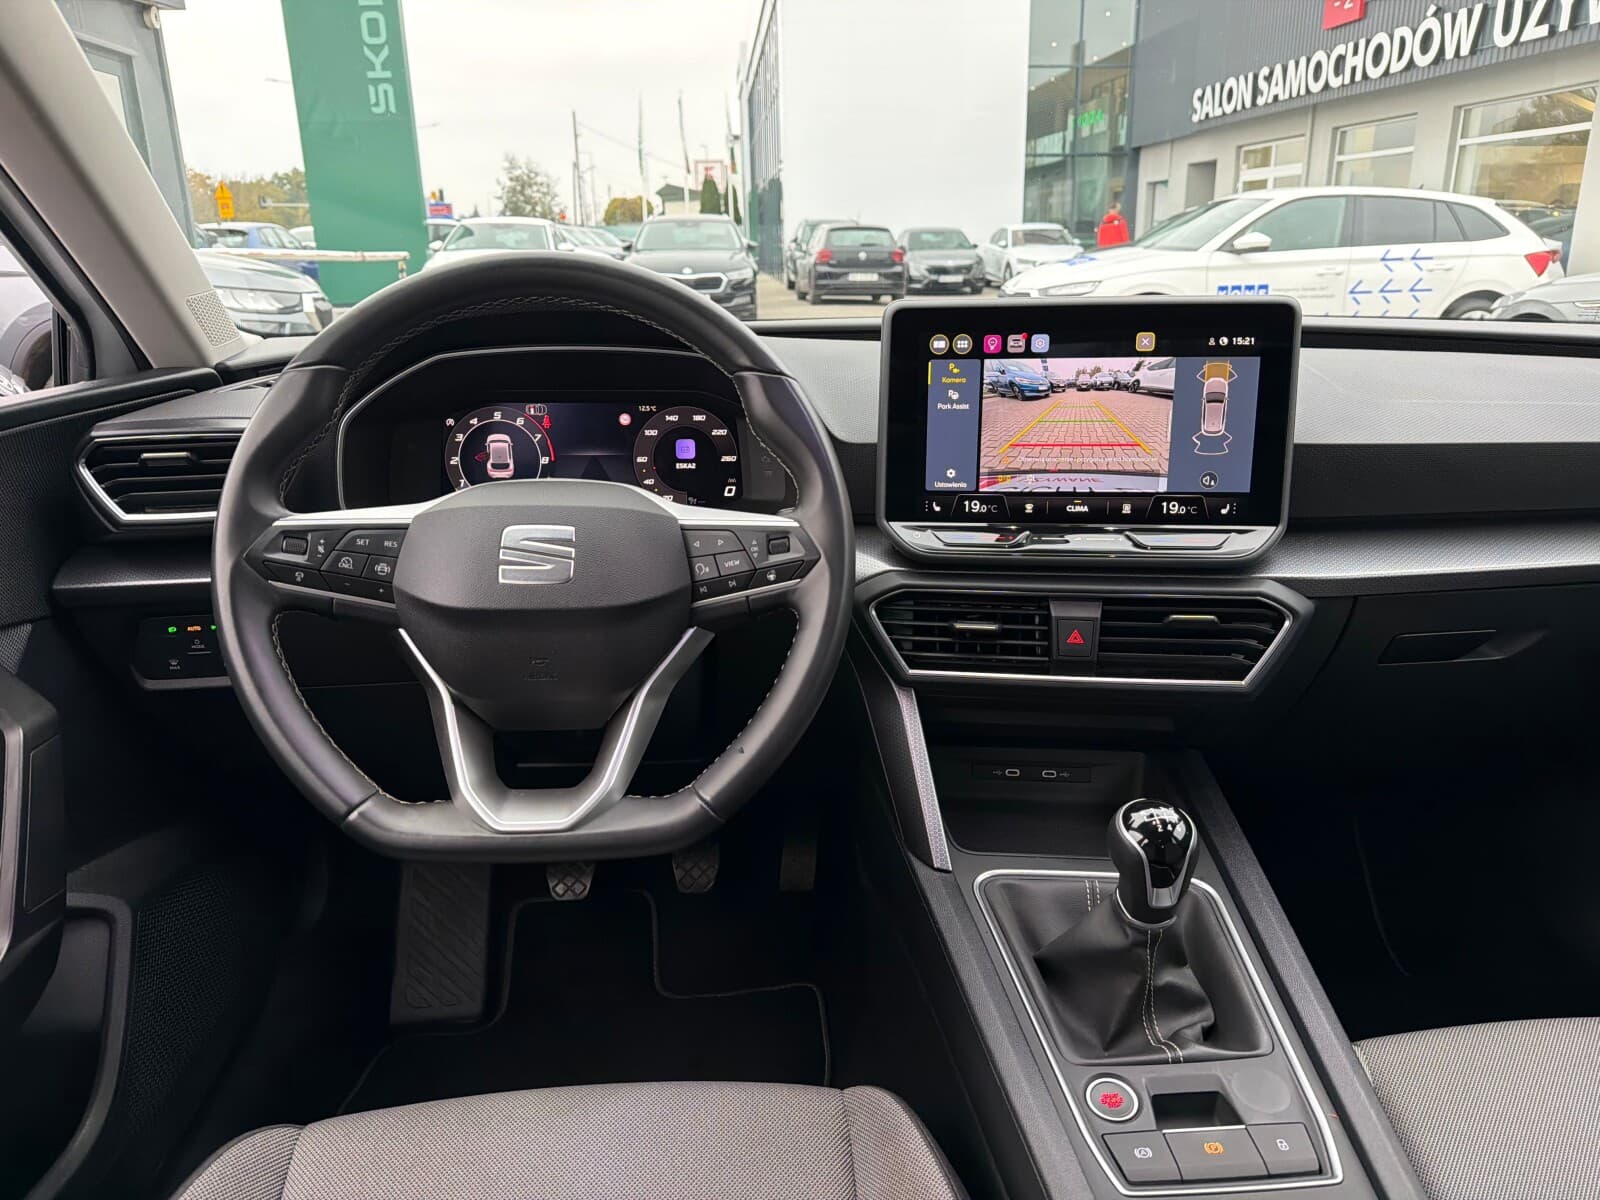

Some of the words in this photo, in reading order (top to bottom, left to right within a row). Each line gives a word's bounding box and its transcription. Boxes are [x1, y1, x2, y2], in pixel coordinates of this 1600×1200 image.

[1191, 72, 1254, 123] SALON
[1256, 3, 1483, 106] SAMOCHODÓW
[1232, 336, 1255, 346] 15:21
[942, 377, 967, 385] Kamera
[356, 538, 369, 546] SET
[384, 540, 398, 548] RES
[723, 560, 740, 568] VIEW
